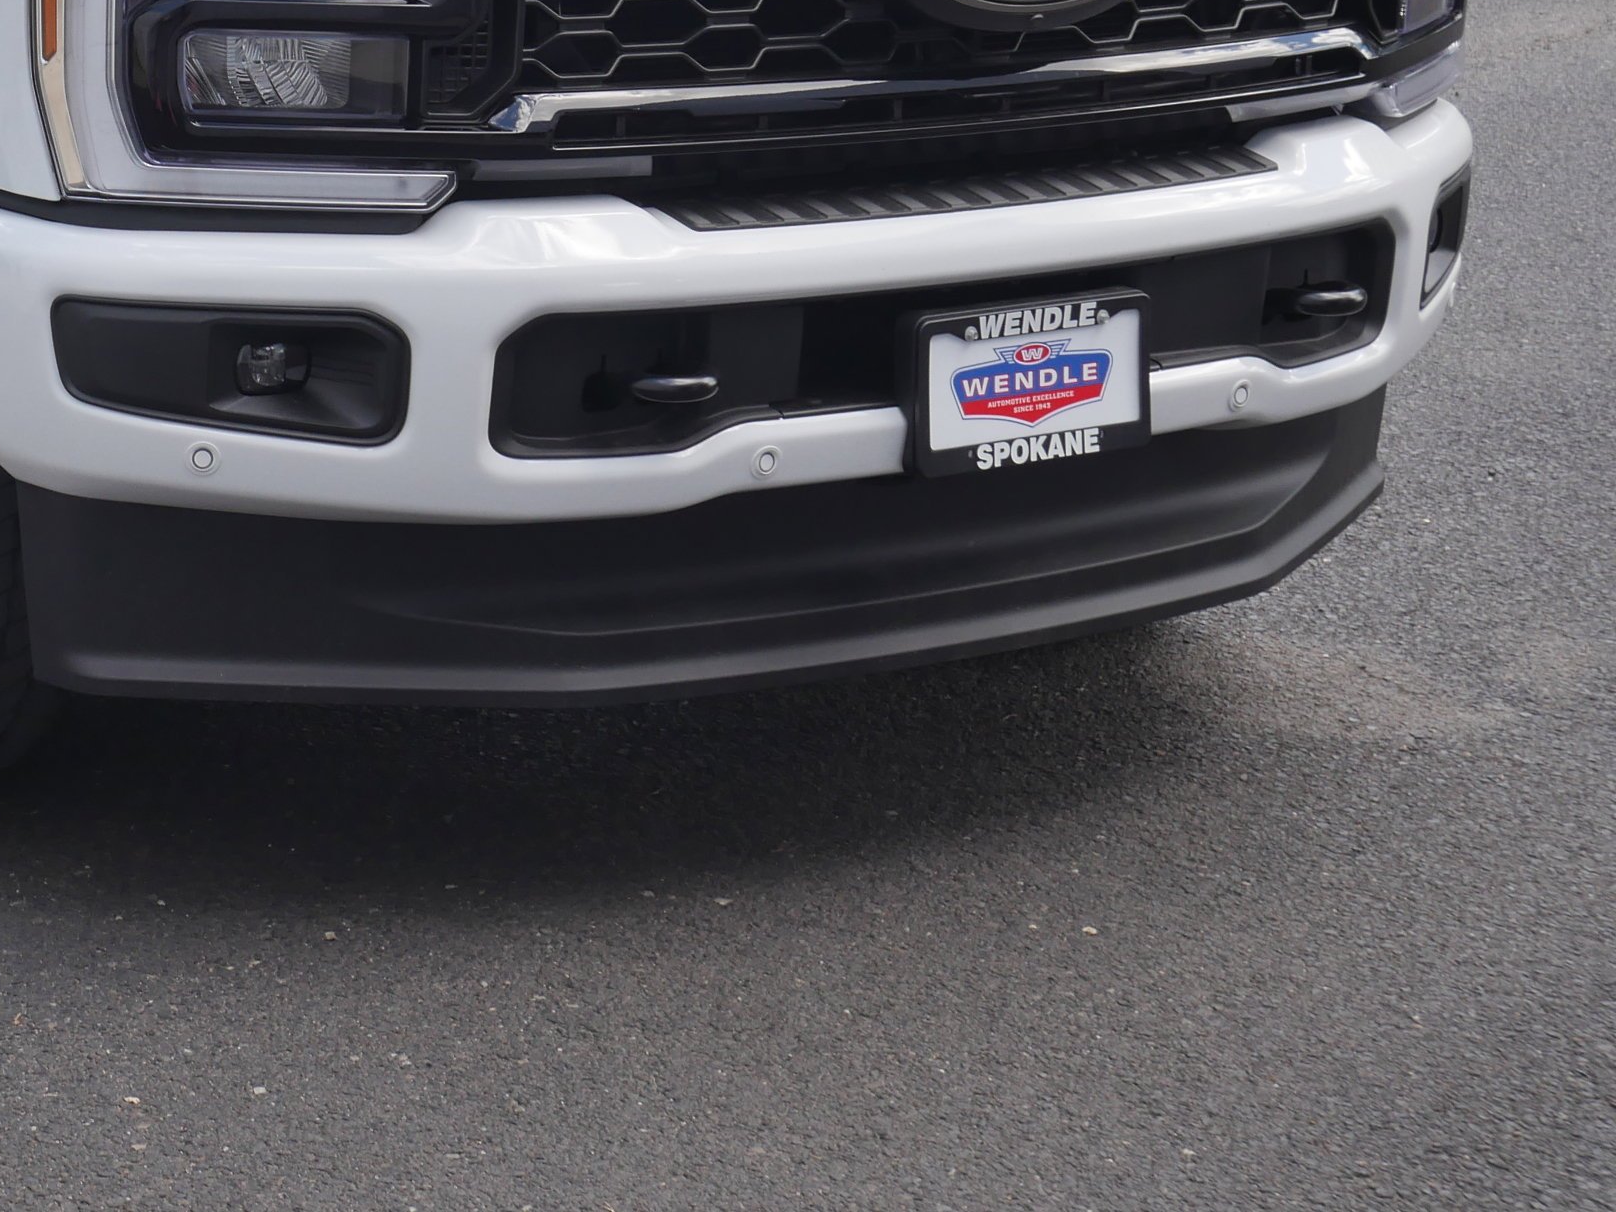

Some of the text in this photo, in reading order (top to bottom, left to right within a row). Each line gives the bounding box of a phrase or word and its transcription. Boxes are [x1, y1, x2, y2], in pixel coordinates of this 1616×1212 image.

[979, 301, 1097, 340] WENDLE
[962, 362, 1098, 398] WENDLE
[987, 390, 1075, 408] AUTOMOTIVE EXCELLENCE
[1013, 402, 1051, 414] SINCE 1943
[976, 427, 1100, 470] SPOKANE
